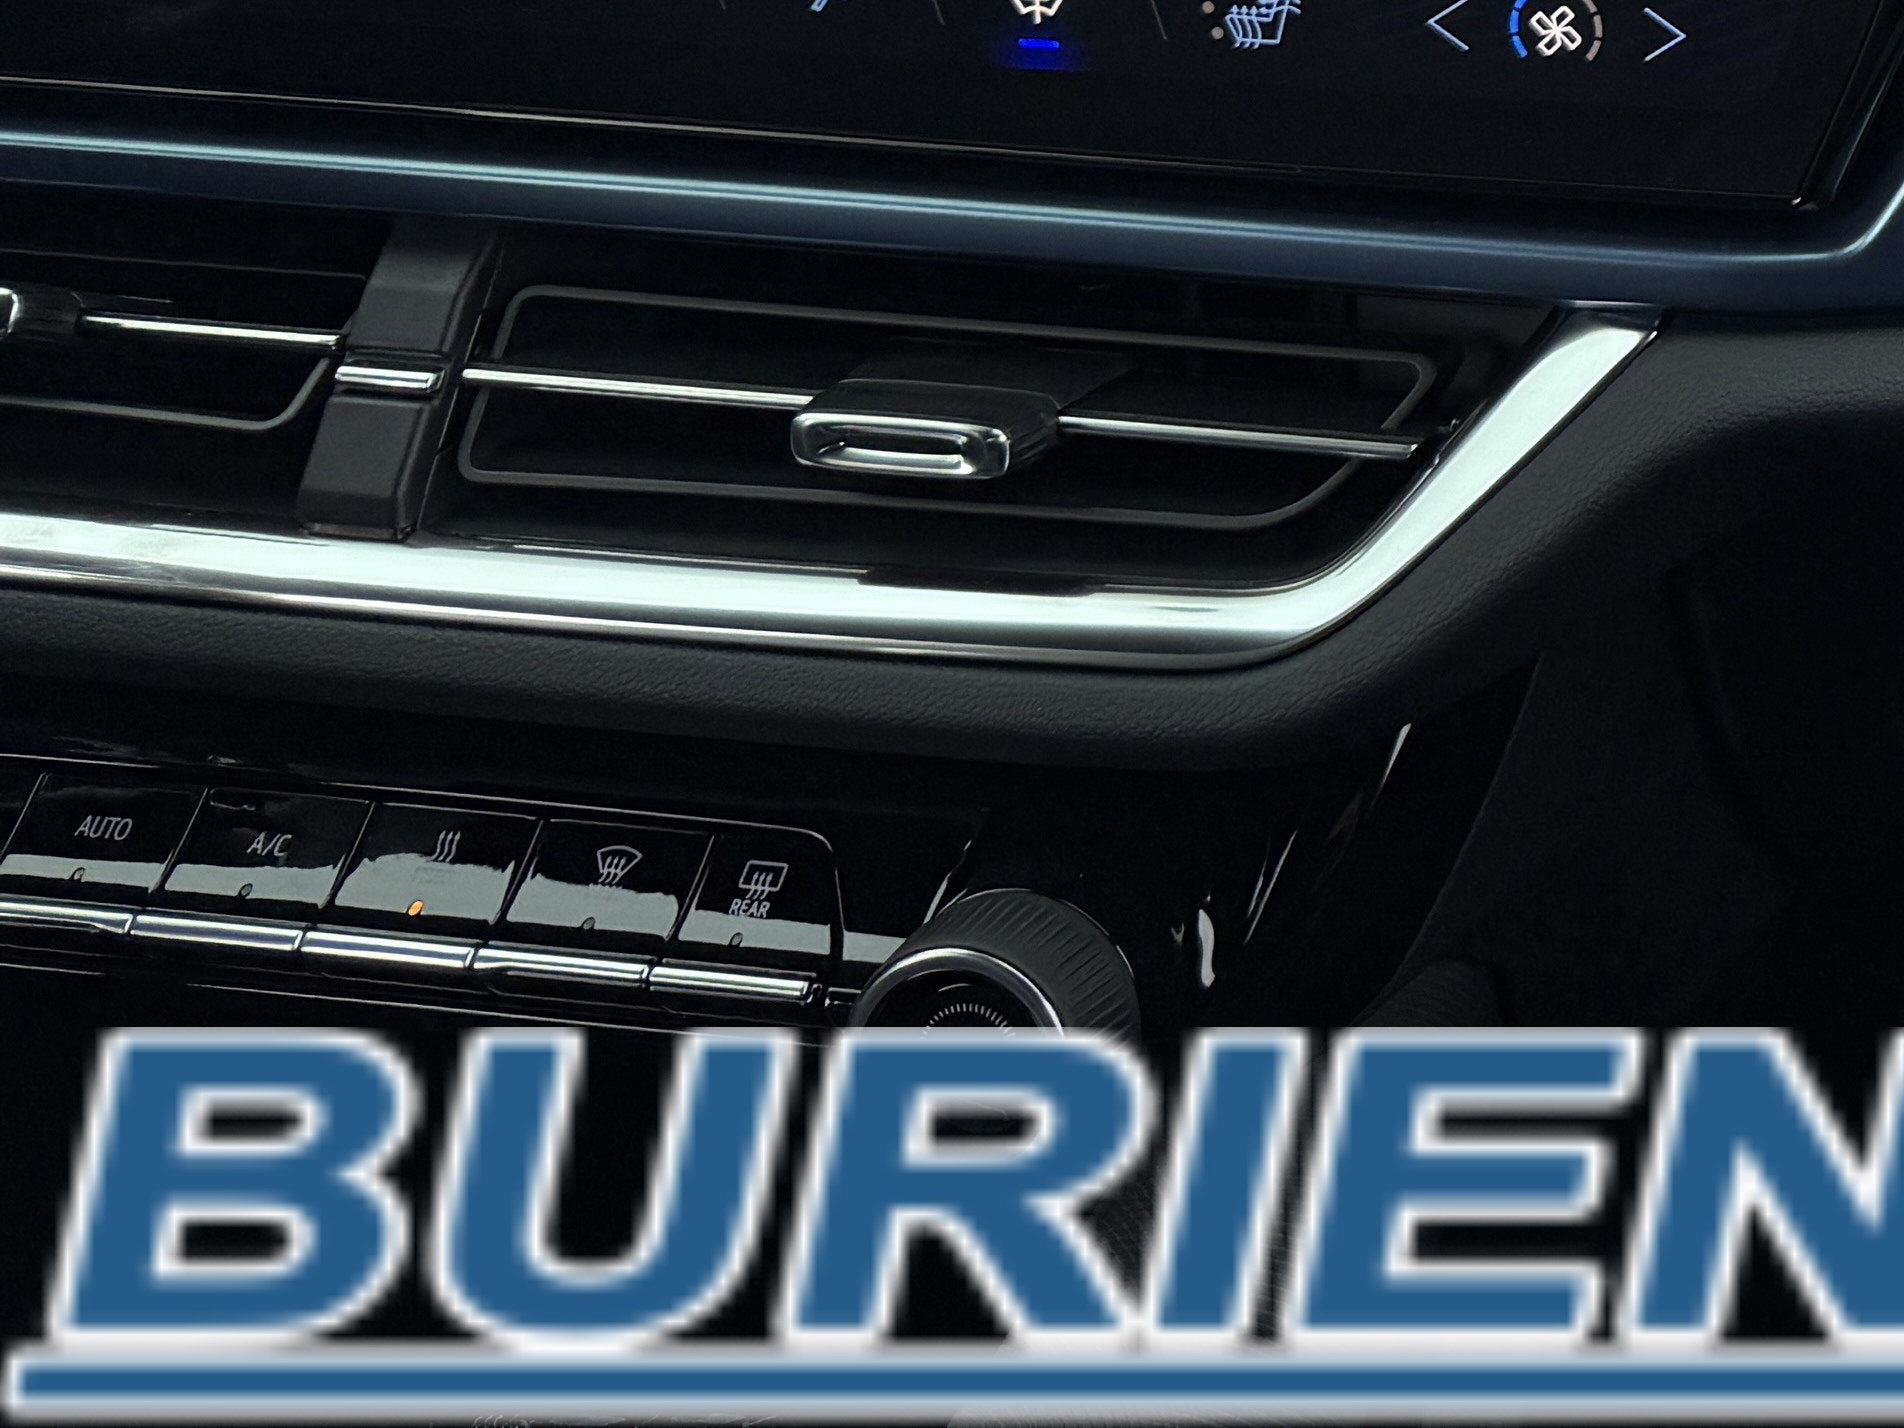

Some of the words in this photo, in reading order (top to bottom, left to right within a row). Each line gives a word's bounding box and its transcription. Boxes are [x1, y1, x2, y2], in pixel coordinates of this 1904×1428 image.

[74, 816, 133, 842] AUTO
[247, 832, 292, 858] A/C
[728, 898, 771, 919] REAR
